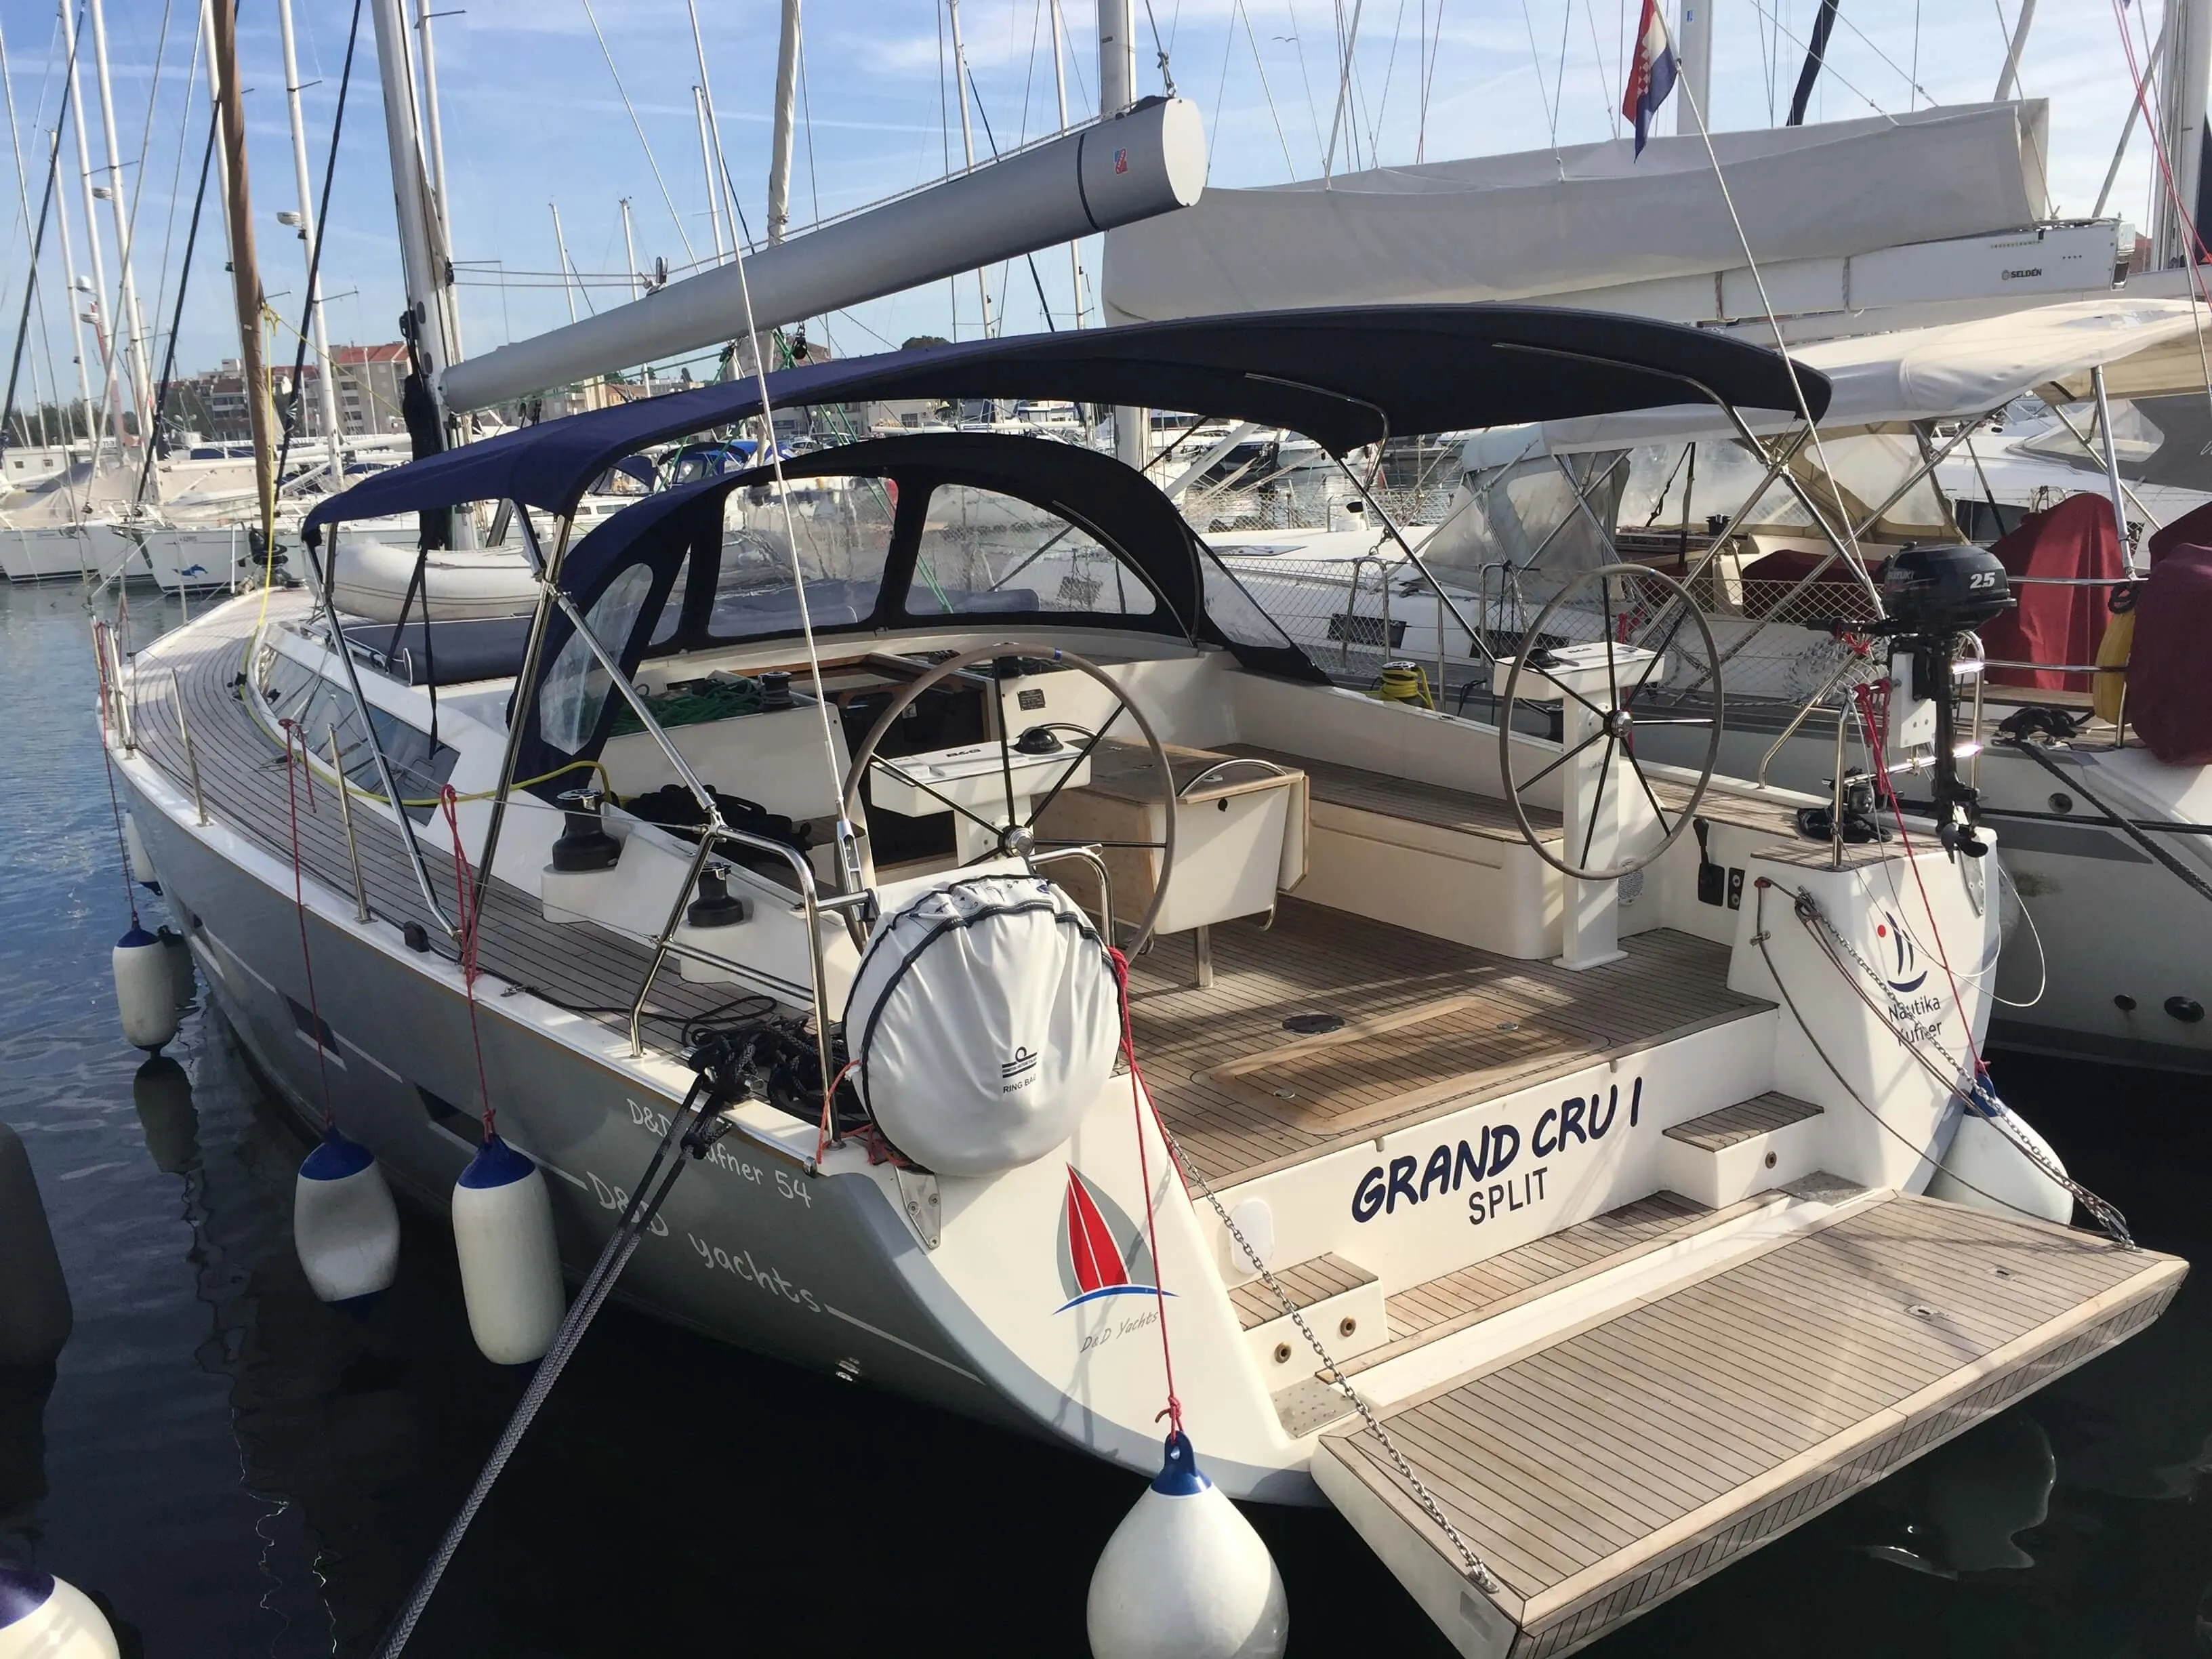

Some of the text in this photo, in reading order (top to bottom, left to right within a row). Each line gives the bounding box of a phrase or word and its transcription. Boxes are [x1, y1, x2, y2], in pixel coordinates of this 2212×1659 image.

[2011, 268, 2042, 278] SELDÉN
[1003, 1082, 1023, 1093] RING
[1352, 1126, 1520, 1223] GRAND
[1532, 1084, 1618, 1157] CRU
[775, 1170, 811, 1208] 54
[1469, 1166, 1548, 1225] SPLIT
[1080, 1311, 1159, 1353] D&D Yachts
